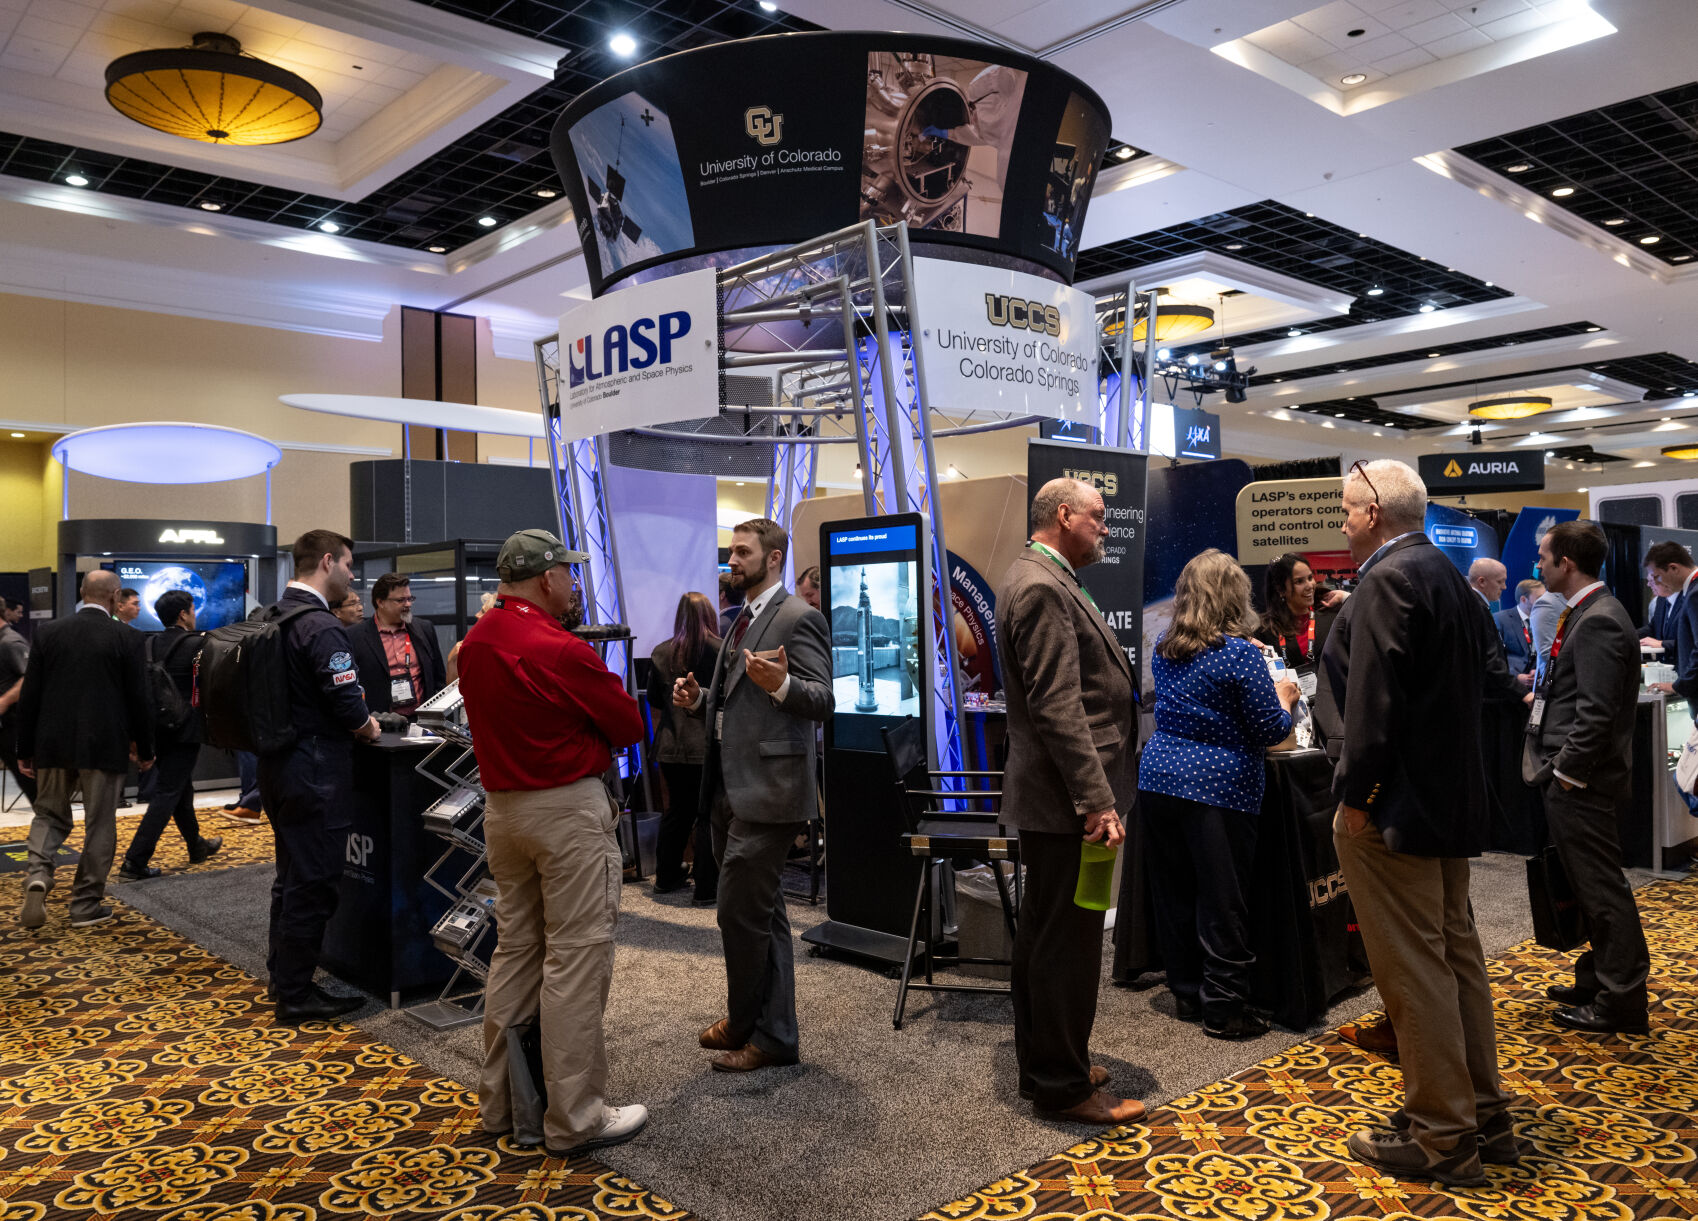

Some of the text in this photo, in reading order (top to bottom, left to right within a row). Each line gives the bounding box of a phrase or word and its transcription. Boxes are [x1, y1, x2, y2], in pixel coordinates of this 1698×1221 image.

[744, 105, 784, 146] CU
[700, 148, 841, 176] University of Colorado
[718, 174, 739, 183] Colorado
[739, 171, 757, 180] Springs
[985, 293, 1061, 337] UCCS
[585, 311, 691, 380] LASP
[937, 329, 1088, 372] University of Colorado
[596, 376, 627, 391] Atmospheric
[628, 373, 641, 383] and
[641, 370, 664, 382] Space
[665, 364, 693, 377] Physics
[959, 357, 1080, 397] Colorado Springs
[602, 389, 620, 399] Boulder
[1468, 461, 1519, 475] AURIA
[1251, 488, 1343, 503] LASP's experie
[1103, 504, 1144, 524] gineering
[1251, 505, 1344, 519] operators com
[1108, 523, 1135, 539] ience
[1252, 519, 1345, 532] and control ou
[1105, 546, 1127, 555] ORADO
[1252, 535, 1309, 547] satellites
[1101, 556, 1120, 564] RINGS
[952, 565, 998, 644] Managem
[951, 591, 985, 646] ace Physics
[1101, 610, 1132, 630] ATE
[335, 673, 356, 684] NASA
[345, 832, 374, 867] SP
